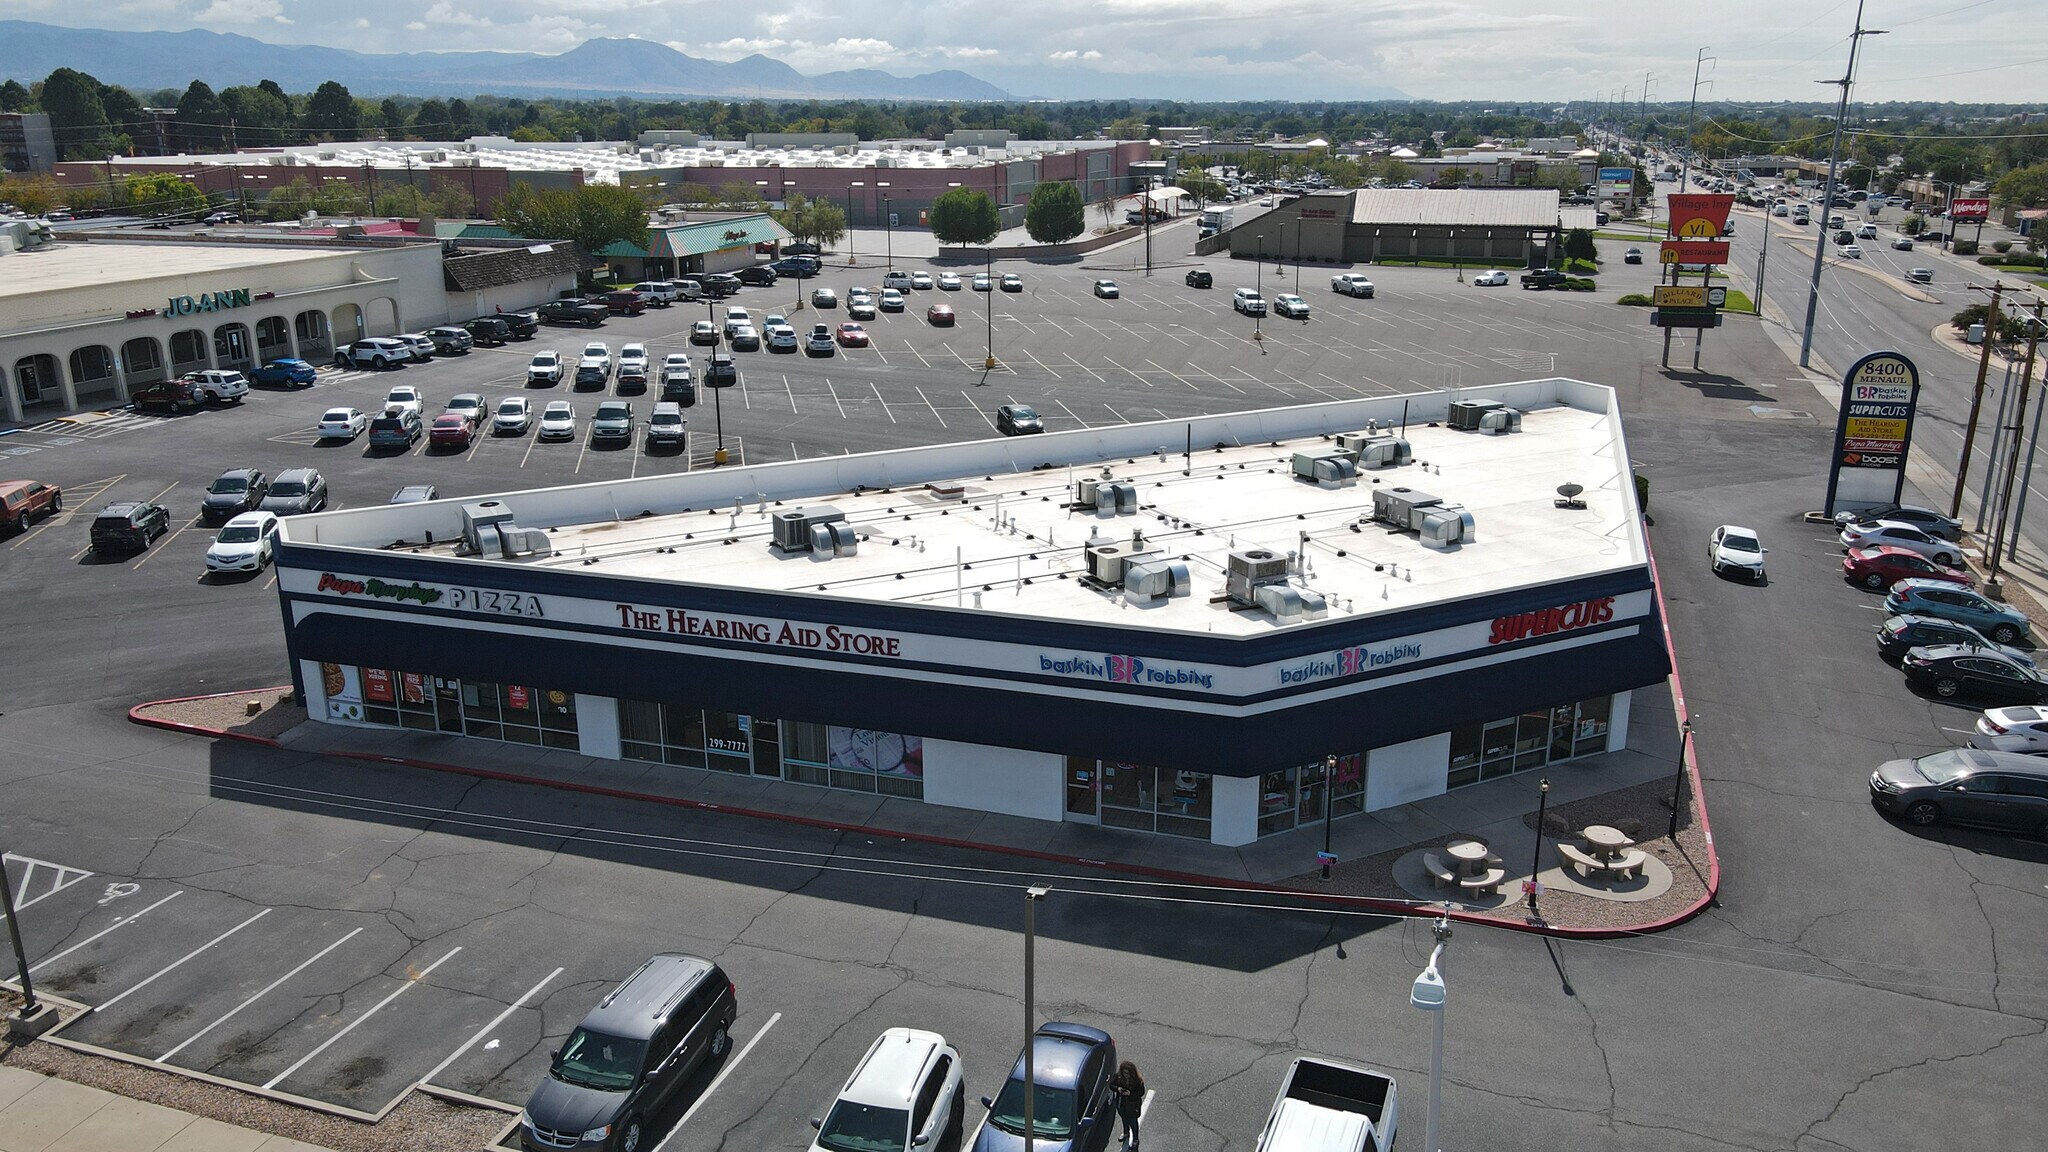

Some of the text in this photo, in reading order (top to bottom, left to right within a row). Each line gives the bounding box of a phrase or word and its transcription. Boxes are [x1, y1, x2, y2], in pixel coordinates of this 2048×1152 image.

[1671, 198, 1731, 211] Village Inn
[1953, 201, 1988, 214] Wendy's
[1662, 289, 1702, 300] BILLIARD
[1864, 362, 1905, 375] 8400
[1859, 376, 1907, 384] MENAUL
[1856, 385, 1878, 400] BR
[1849, 404, 1908, 416] SUPERCUTS
[1844, 439, 1866, 449] Papa
[1862, 454, 1899, 464] boost
[317, 572, 365, 595] Papa
[449, 588, 544, 617] PIZZA
[1488, 596, 1616, 644] SUPERCUTS
[616, 604, 901, 657] THE HEARING AID STORE
[1281, 643, 1422, 684] baskin BR robbins
[1039, 653, 1213, 689] baskin BR robbins
[708, 737, 746, 752] 299-7777
